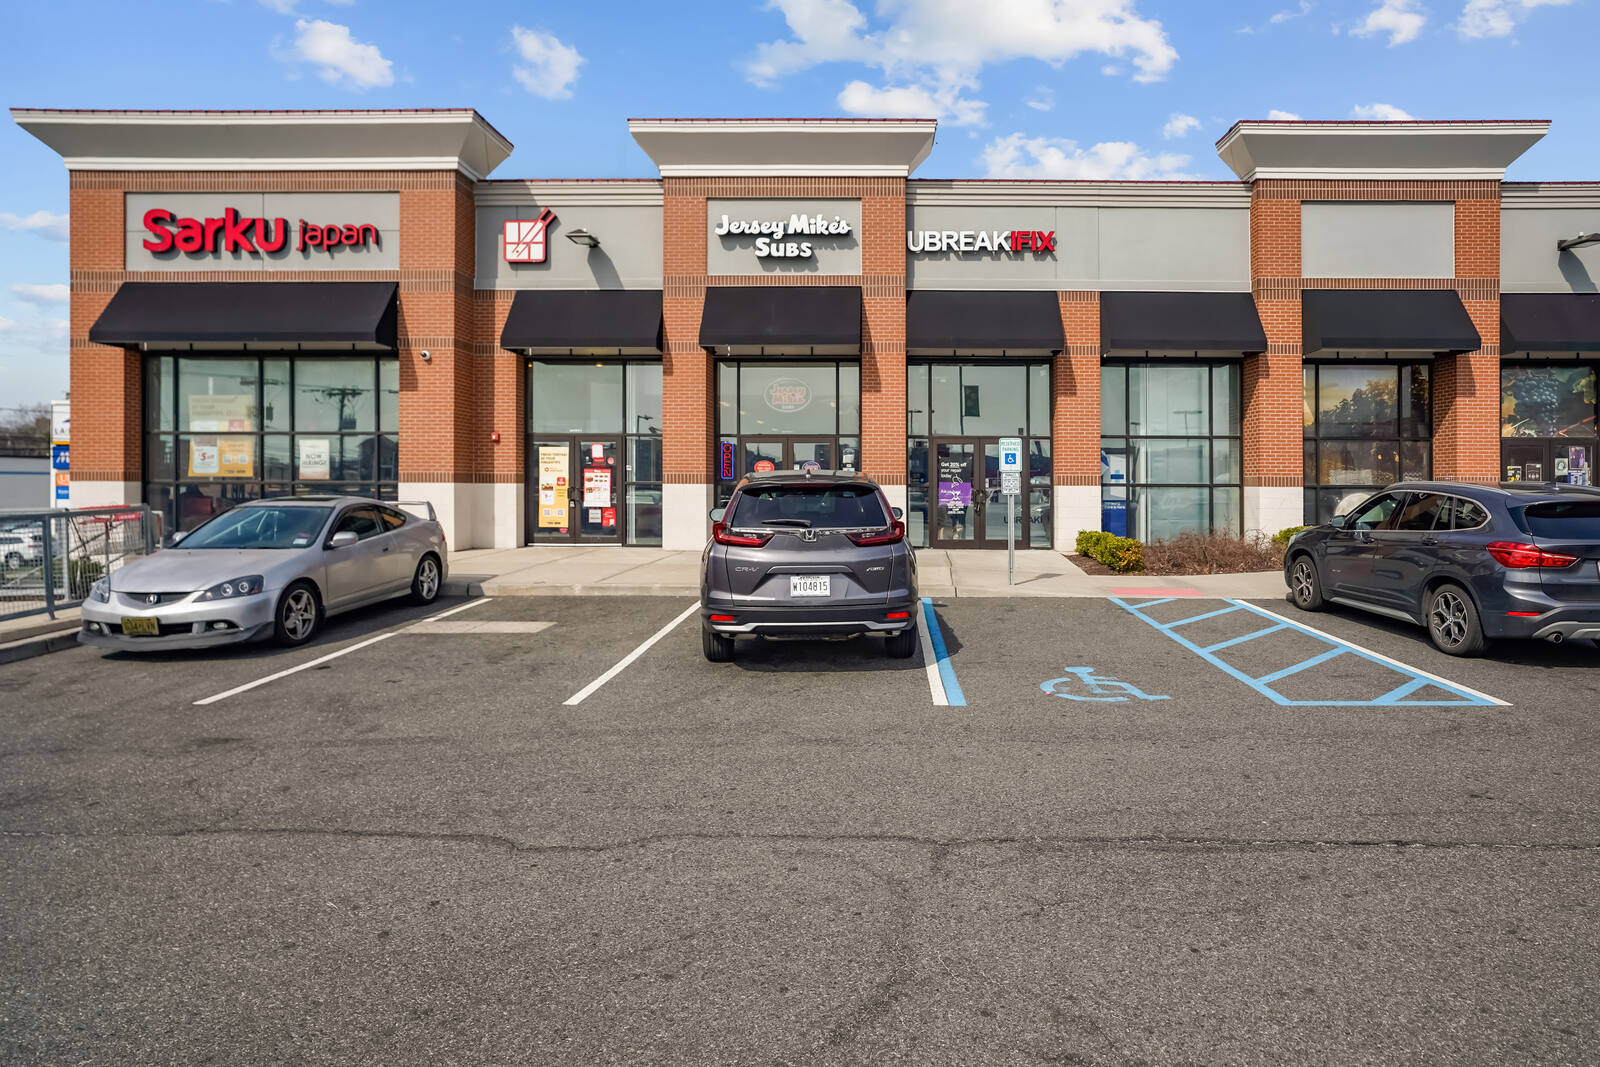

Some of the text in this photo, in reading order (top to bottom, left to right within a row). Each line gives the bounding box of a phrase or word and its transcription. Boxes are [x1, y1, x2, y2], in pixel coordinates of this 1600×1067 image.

[143, 207, 377, 253] Sarku japan
[714, 214, 852, 240] Jersey Mike's
[907, 230, 1056, 252] UBREAKIFIX
[722, 443, 732, 477] OPEN
